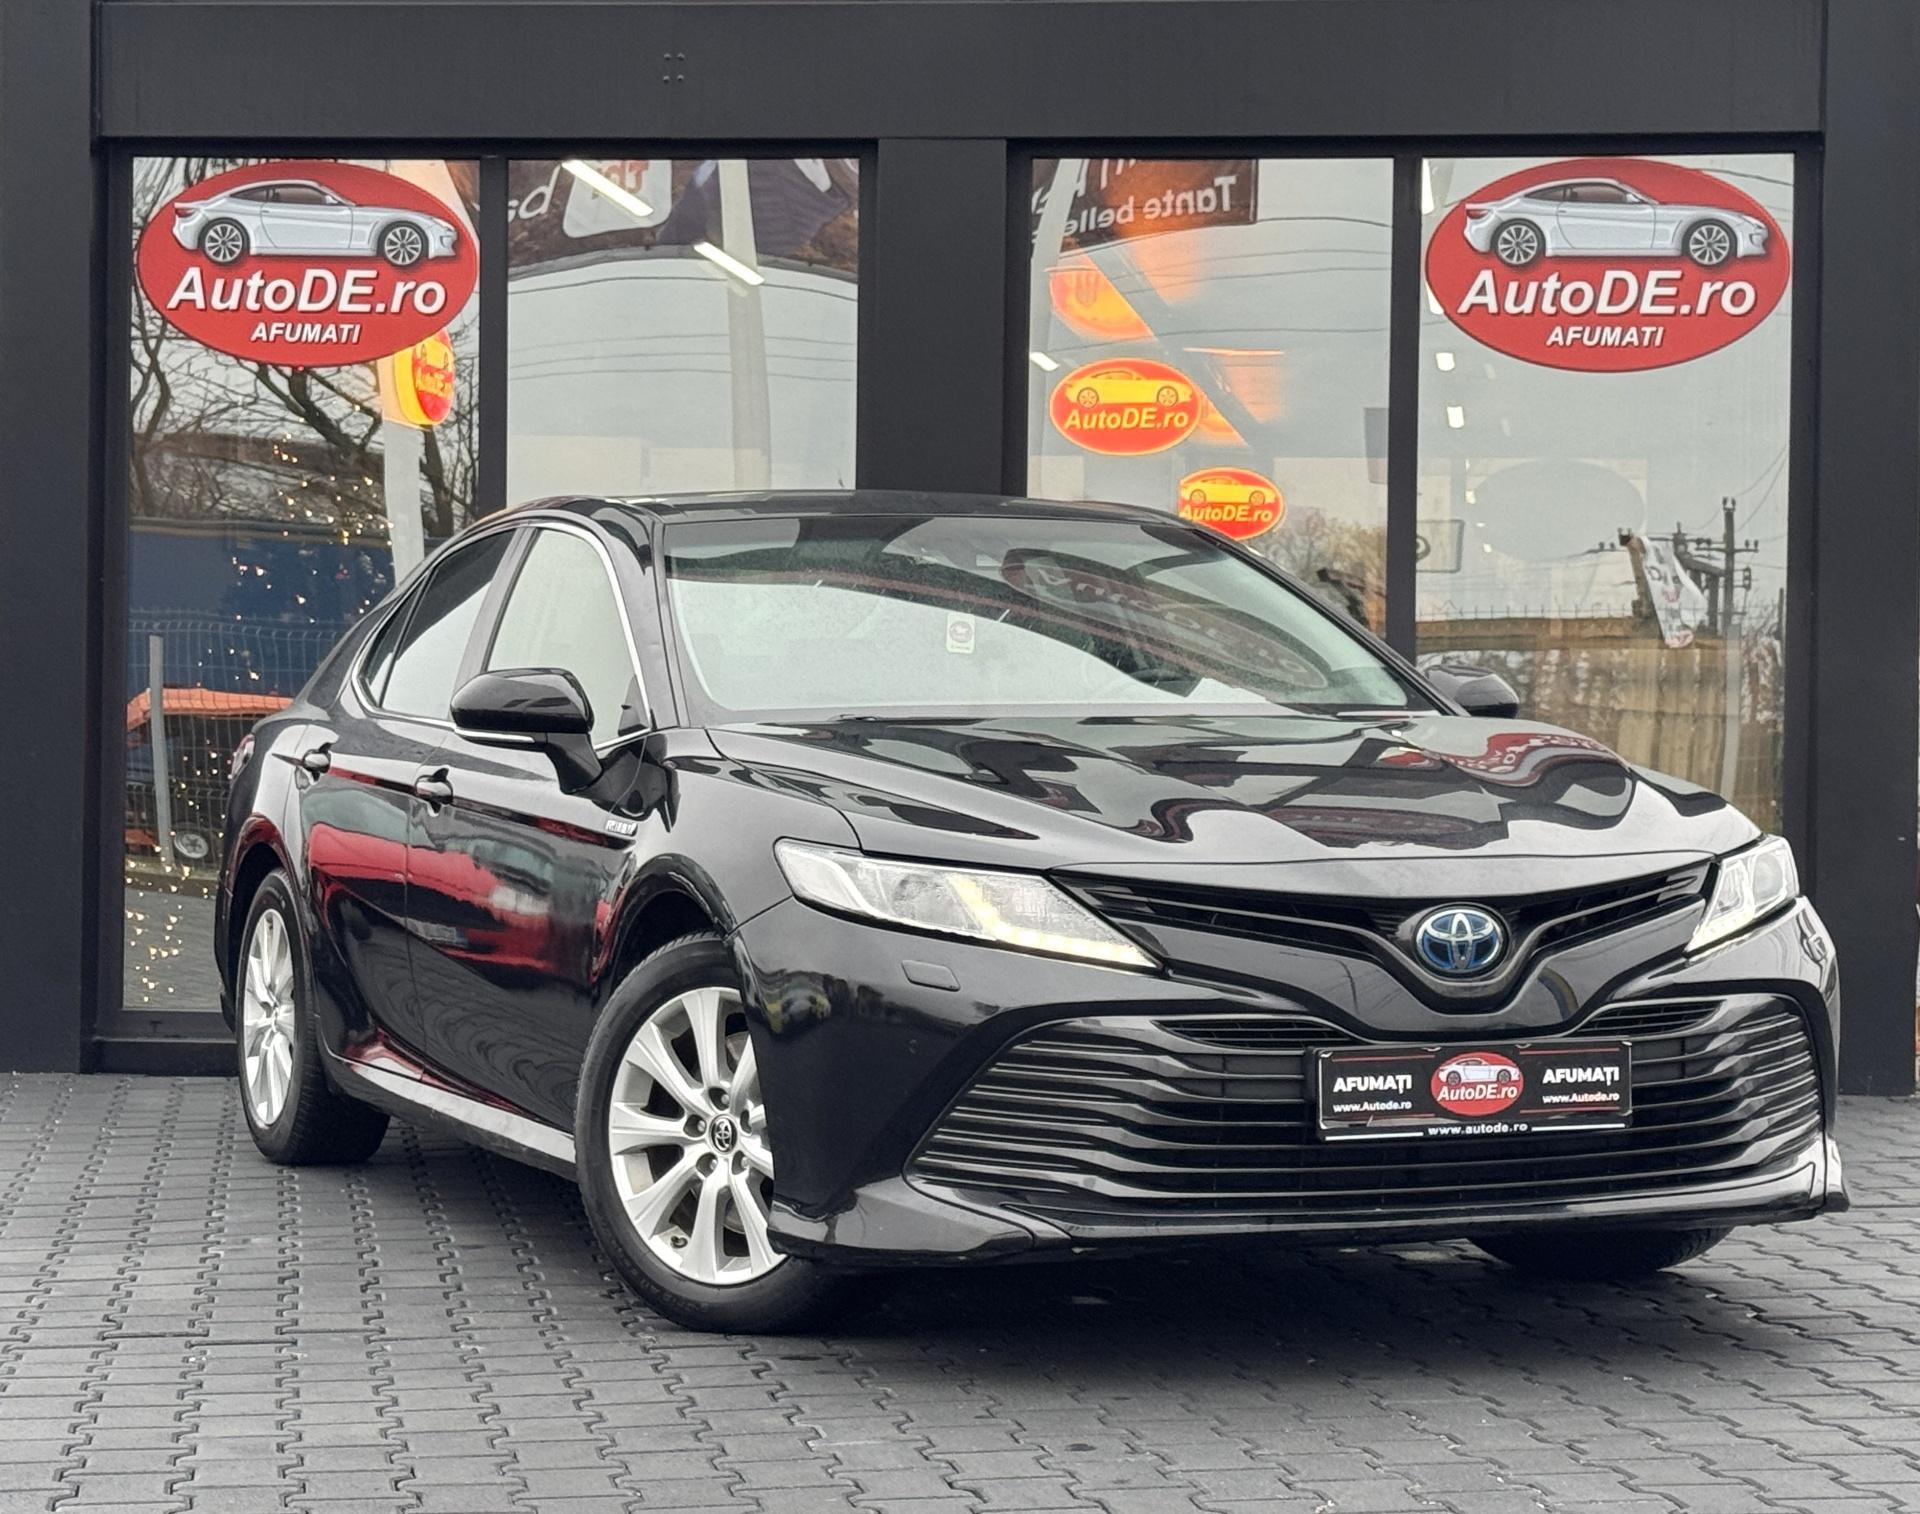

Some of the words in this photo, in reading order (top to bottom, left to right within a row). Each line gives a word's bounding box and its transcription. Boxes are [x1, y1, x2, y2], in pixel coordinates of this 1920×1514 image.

[167, 267, 447, 315] AutoDE.ro
[1457, 269, 1756, 316] AutoDE.ro
[251, 322, 361, 344] AFUMATI
[1546, 327, 1664, 347] AFUMATI
[1064, 407, 1189, 430] AutoDE.ro
[1179, 504, 1273, 522] AutoDE.ro
[1437, 1084, 1517, 1101] AutoDE.ro
[1542, 1092, 1620, 1103] www.Autode.ro
[1333, 1101, 1412, 1112] www.Autode.ro
[1428, 1123, 1528, 1136] www.autode.ro
